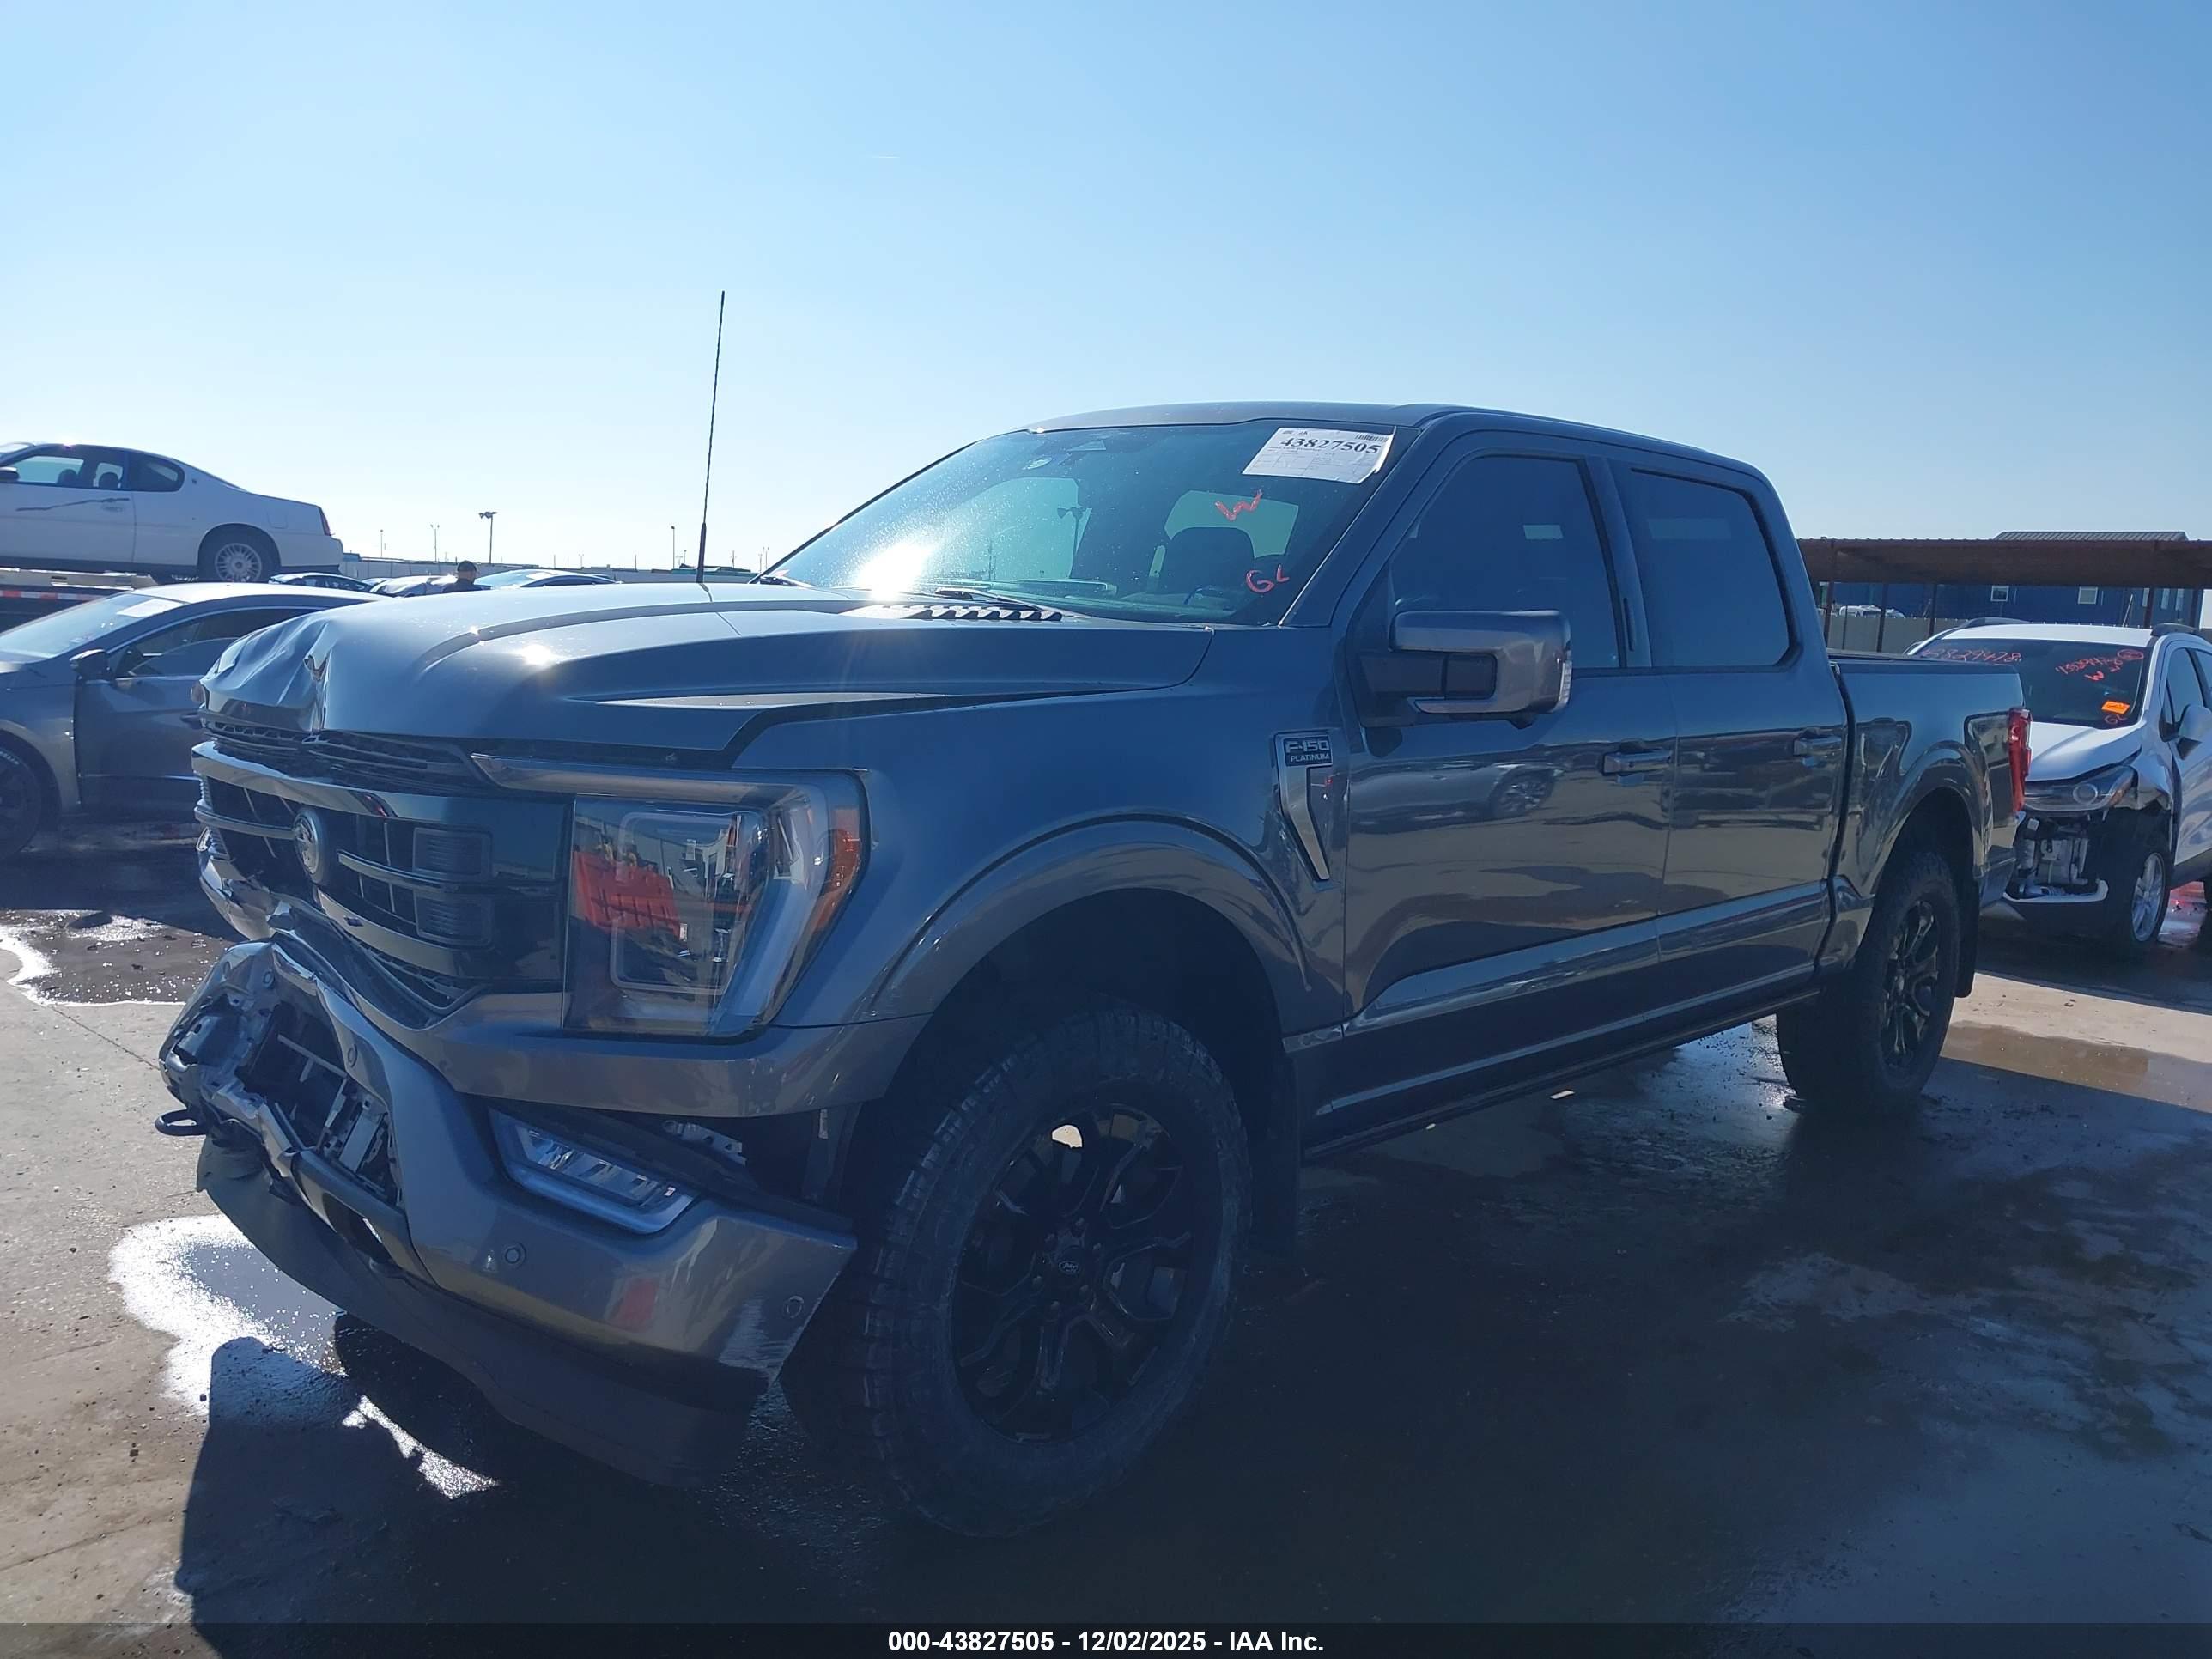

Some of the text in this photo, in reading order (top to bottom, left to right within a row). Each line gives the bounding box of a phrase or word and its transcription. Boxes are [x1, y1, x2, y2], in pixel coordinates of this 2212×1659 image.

[1280, 437, 1382, 454] 43827505
[1285, 740, 1330, 753] F-150
[1291, 753, 1330, 763] PLATINUM
